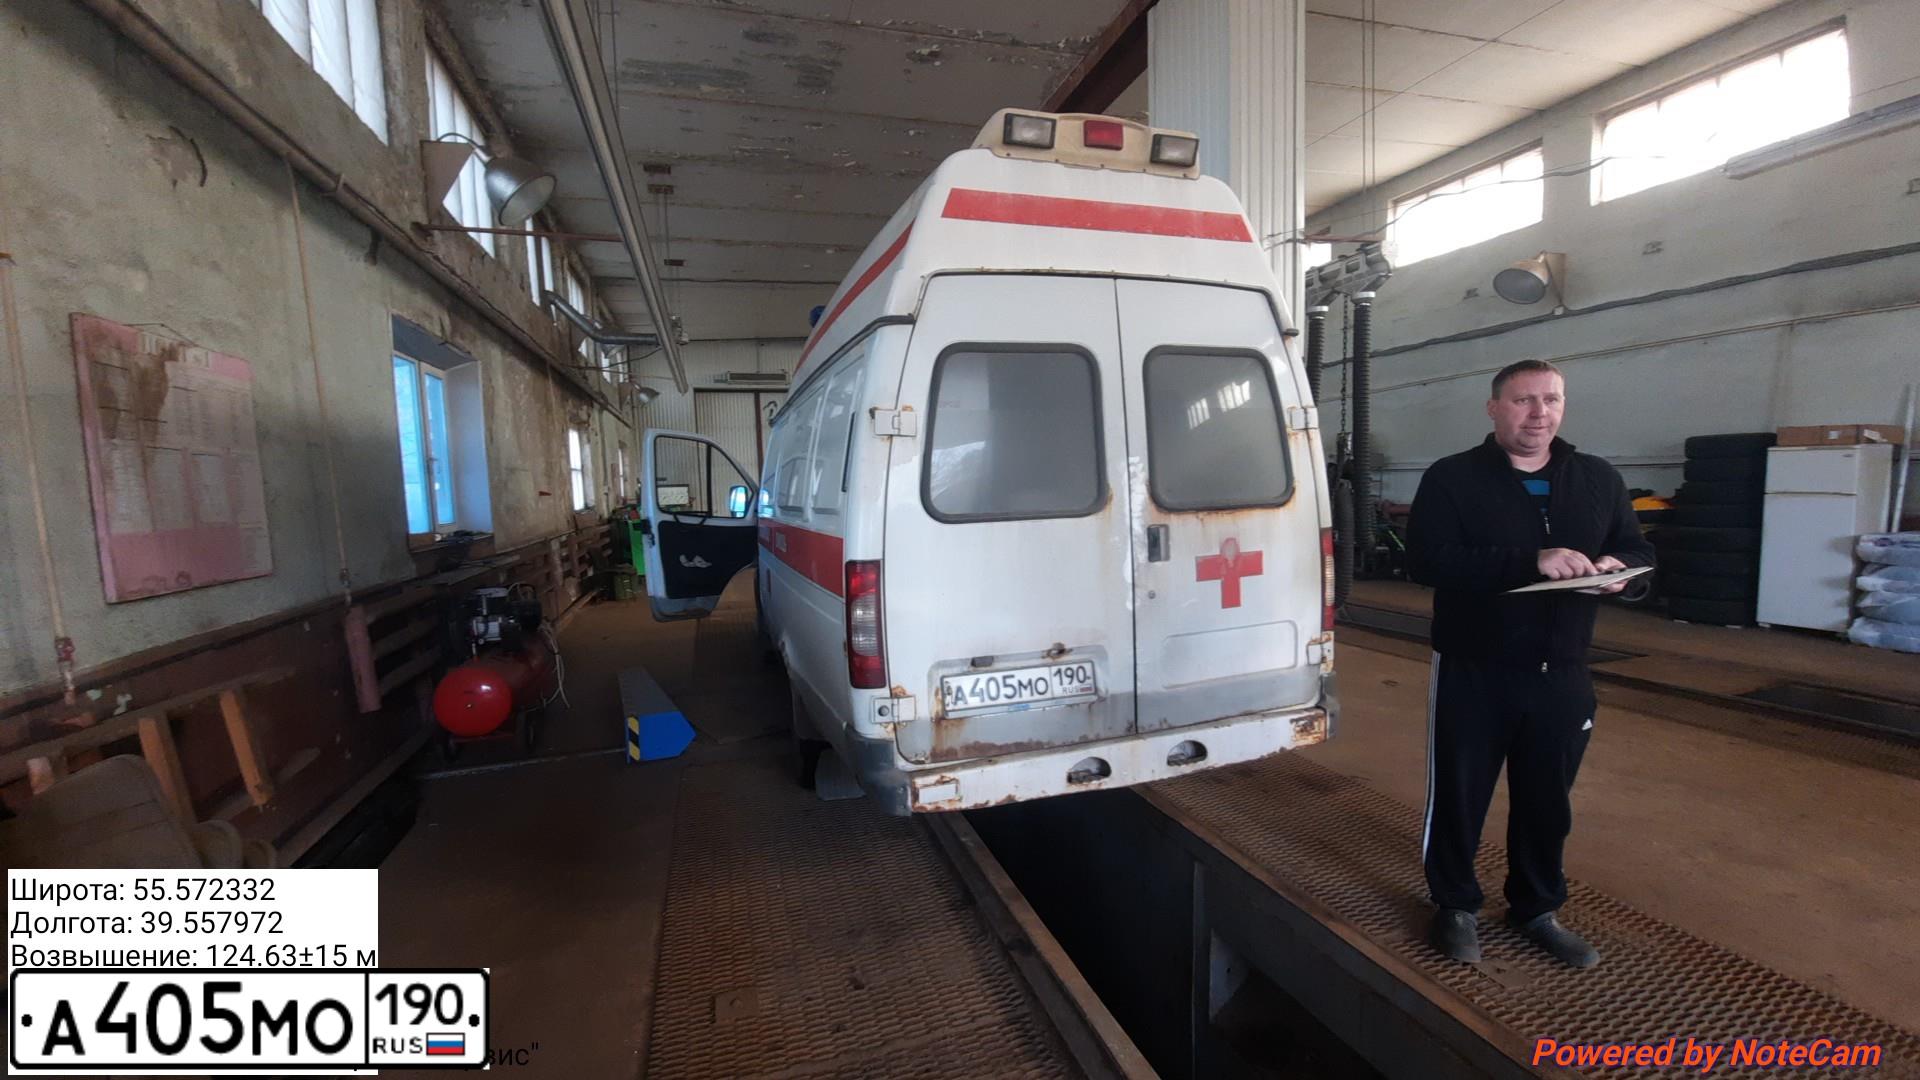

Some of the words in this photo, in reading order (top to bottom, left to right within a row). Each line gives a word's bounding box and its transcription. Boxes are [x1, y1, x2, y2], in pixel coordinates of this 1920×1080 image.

[953, 674, 1049, 706] А405МО
[1053, 665, 1087, 687] 190
[1062, 685, 1080, 695] RUS
